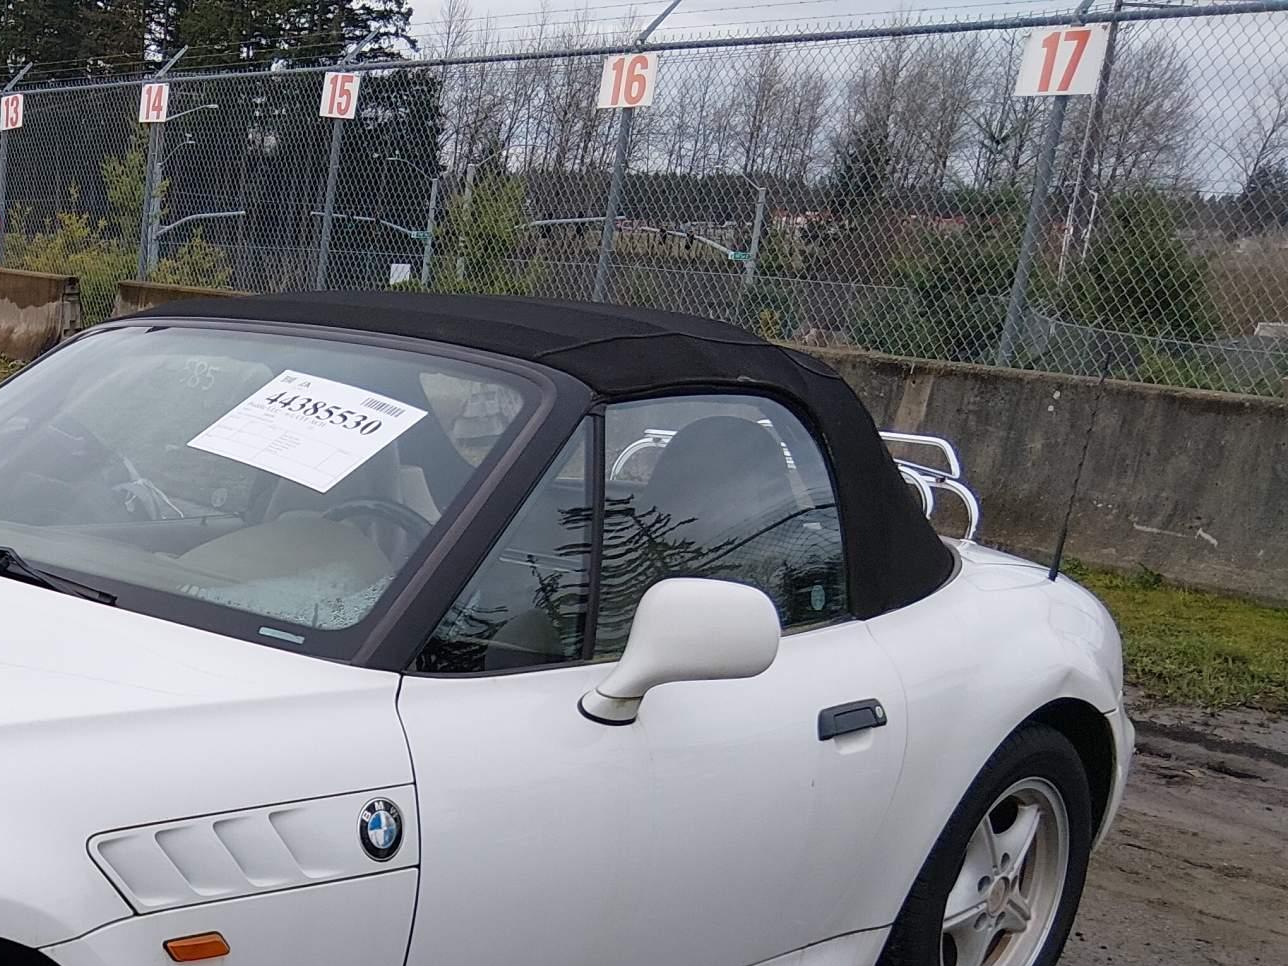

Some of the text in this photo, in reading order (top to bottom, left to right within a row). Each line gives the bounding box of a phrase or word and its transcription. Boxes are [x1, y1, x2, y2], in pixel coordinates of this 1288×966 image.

[610, 56, 648, 106] 16
[1037, 30, 1090, 92] 17
[4, 96, 20, 128] 13
[144, 84, 165, 120] 14
[327, 74, 355, 114] 15
[265, 391, 383, 436] 44385530
